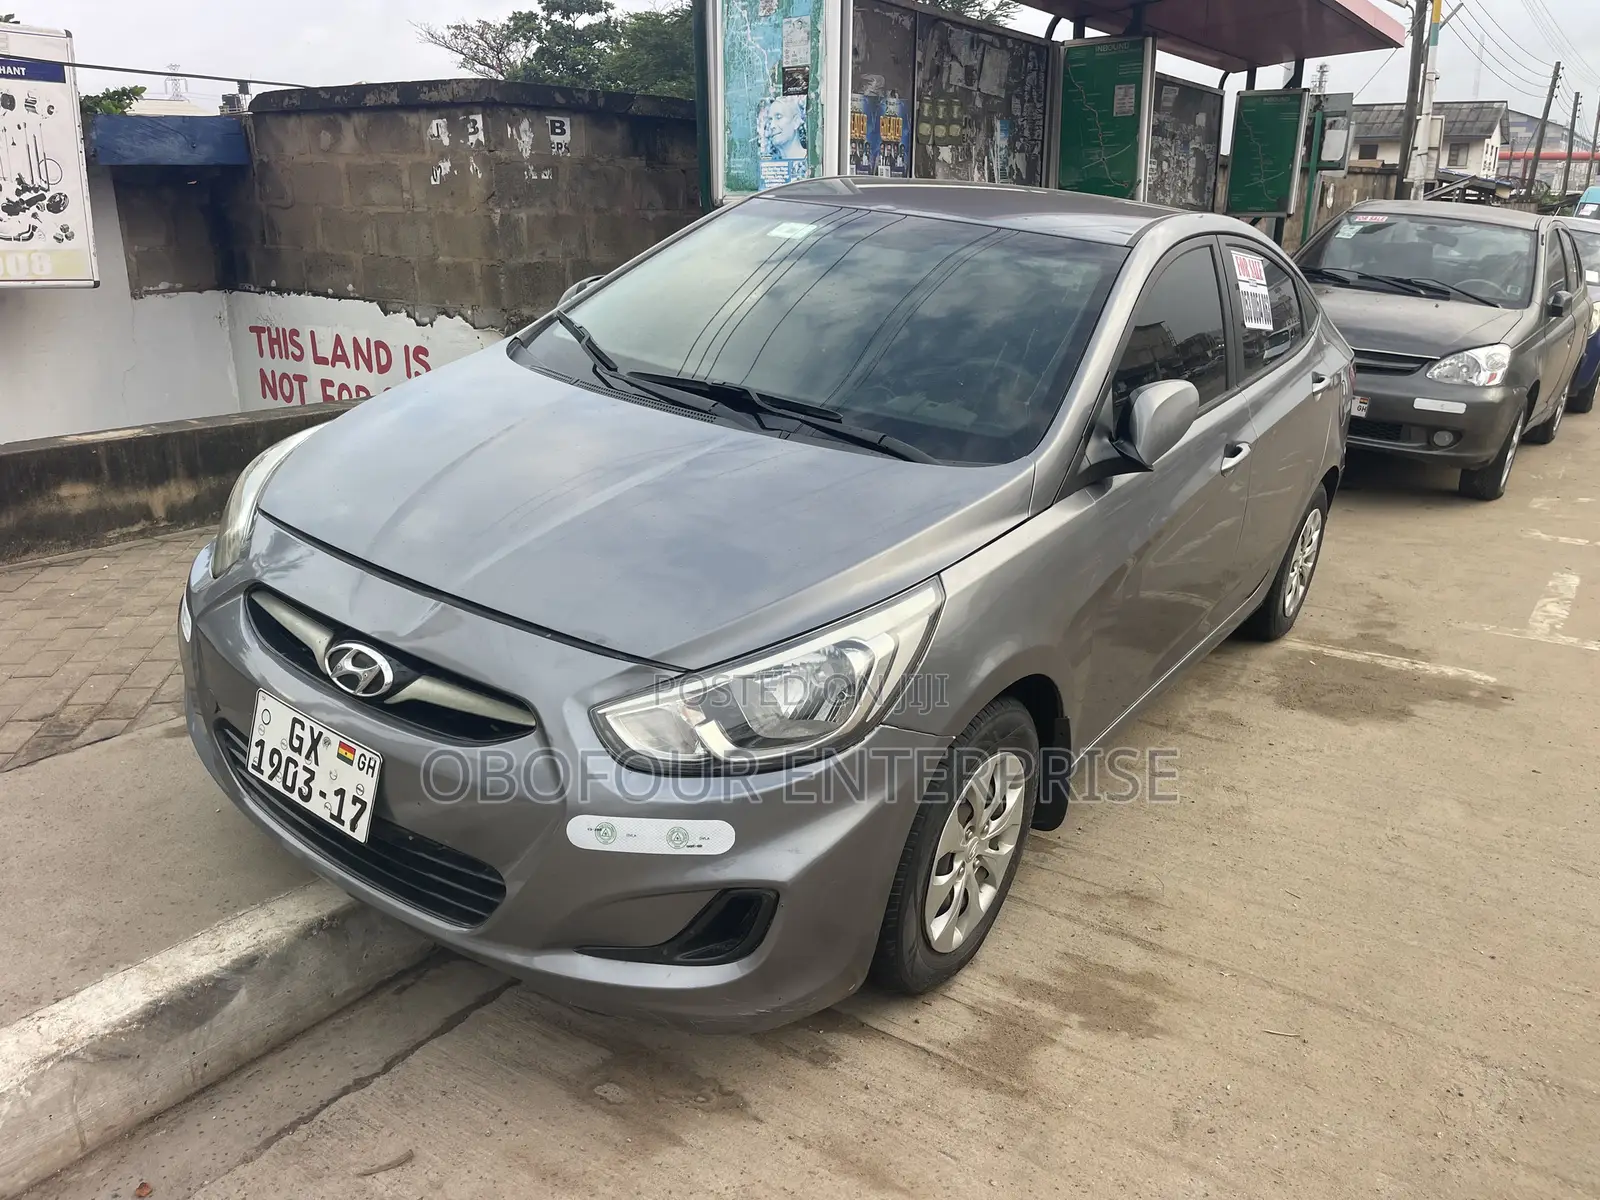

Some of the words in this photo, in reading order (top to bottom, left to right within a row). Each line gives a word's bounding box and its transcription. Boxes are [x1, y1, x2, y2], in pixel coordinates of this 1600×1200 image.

[0, 251, 52, 276] 08
[249, 326, 305, 362] THIS
[310, 330, 393, 375] LAND
[404, 344, 432, 379] IS
[259, 367, 308, 405] NOT
[288, 716, 324, 767] GX
[251, 738, 368, 833] 1903-17
[357, 753, 376, 778] GH
